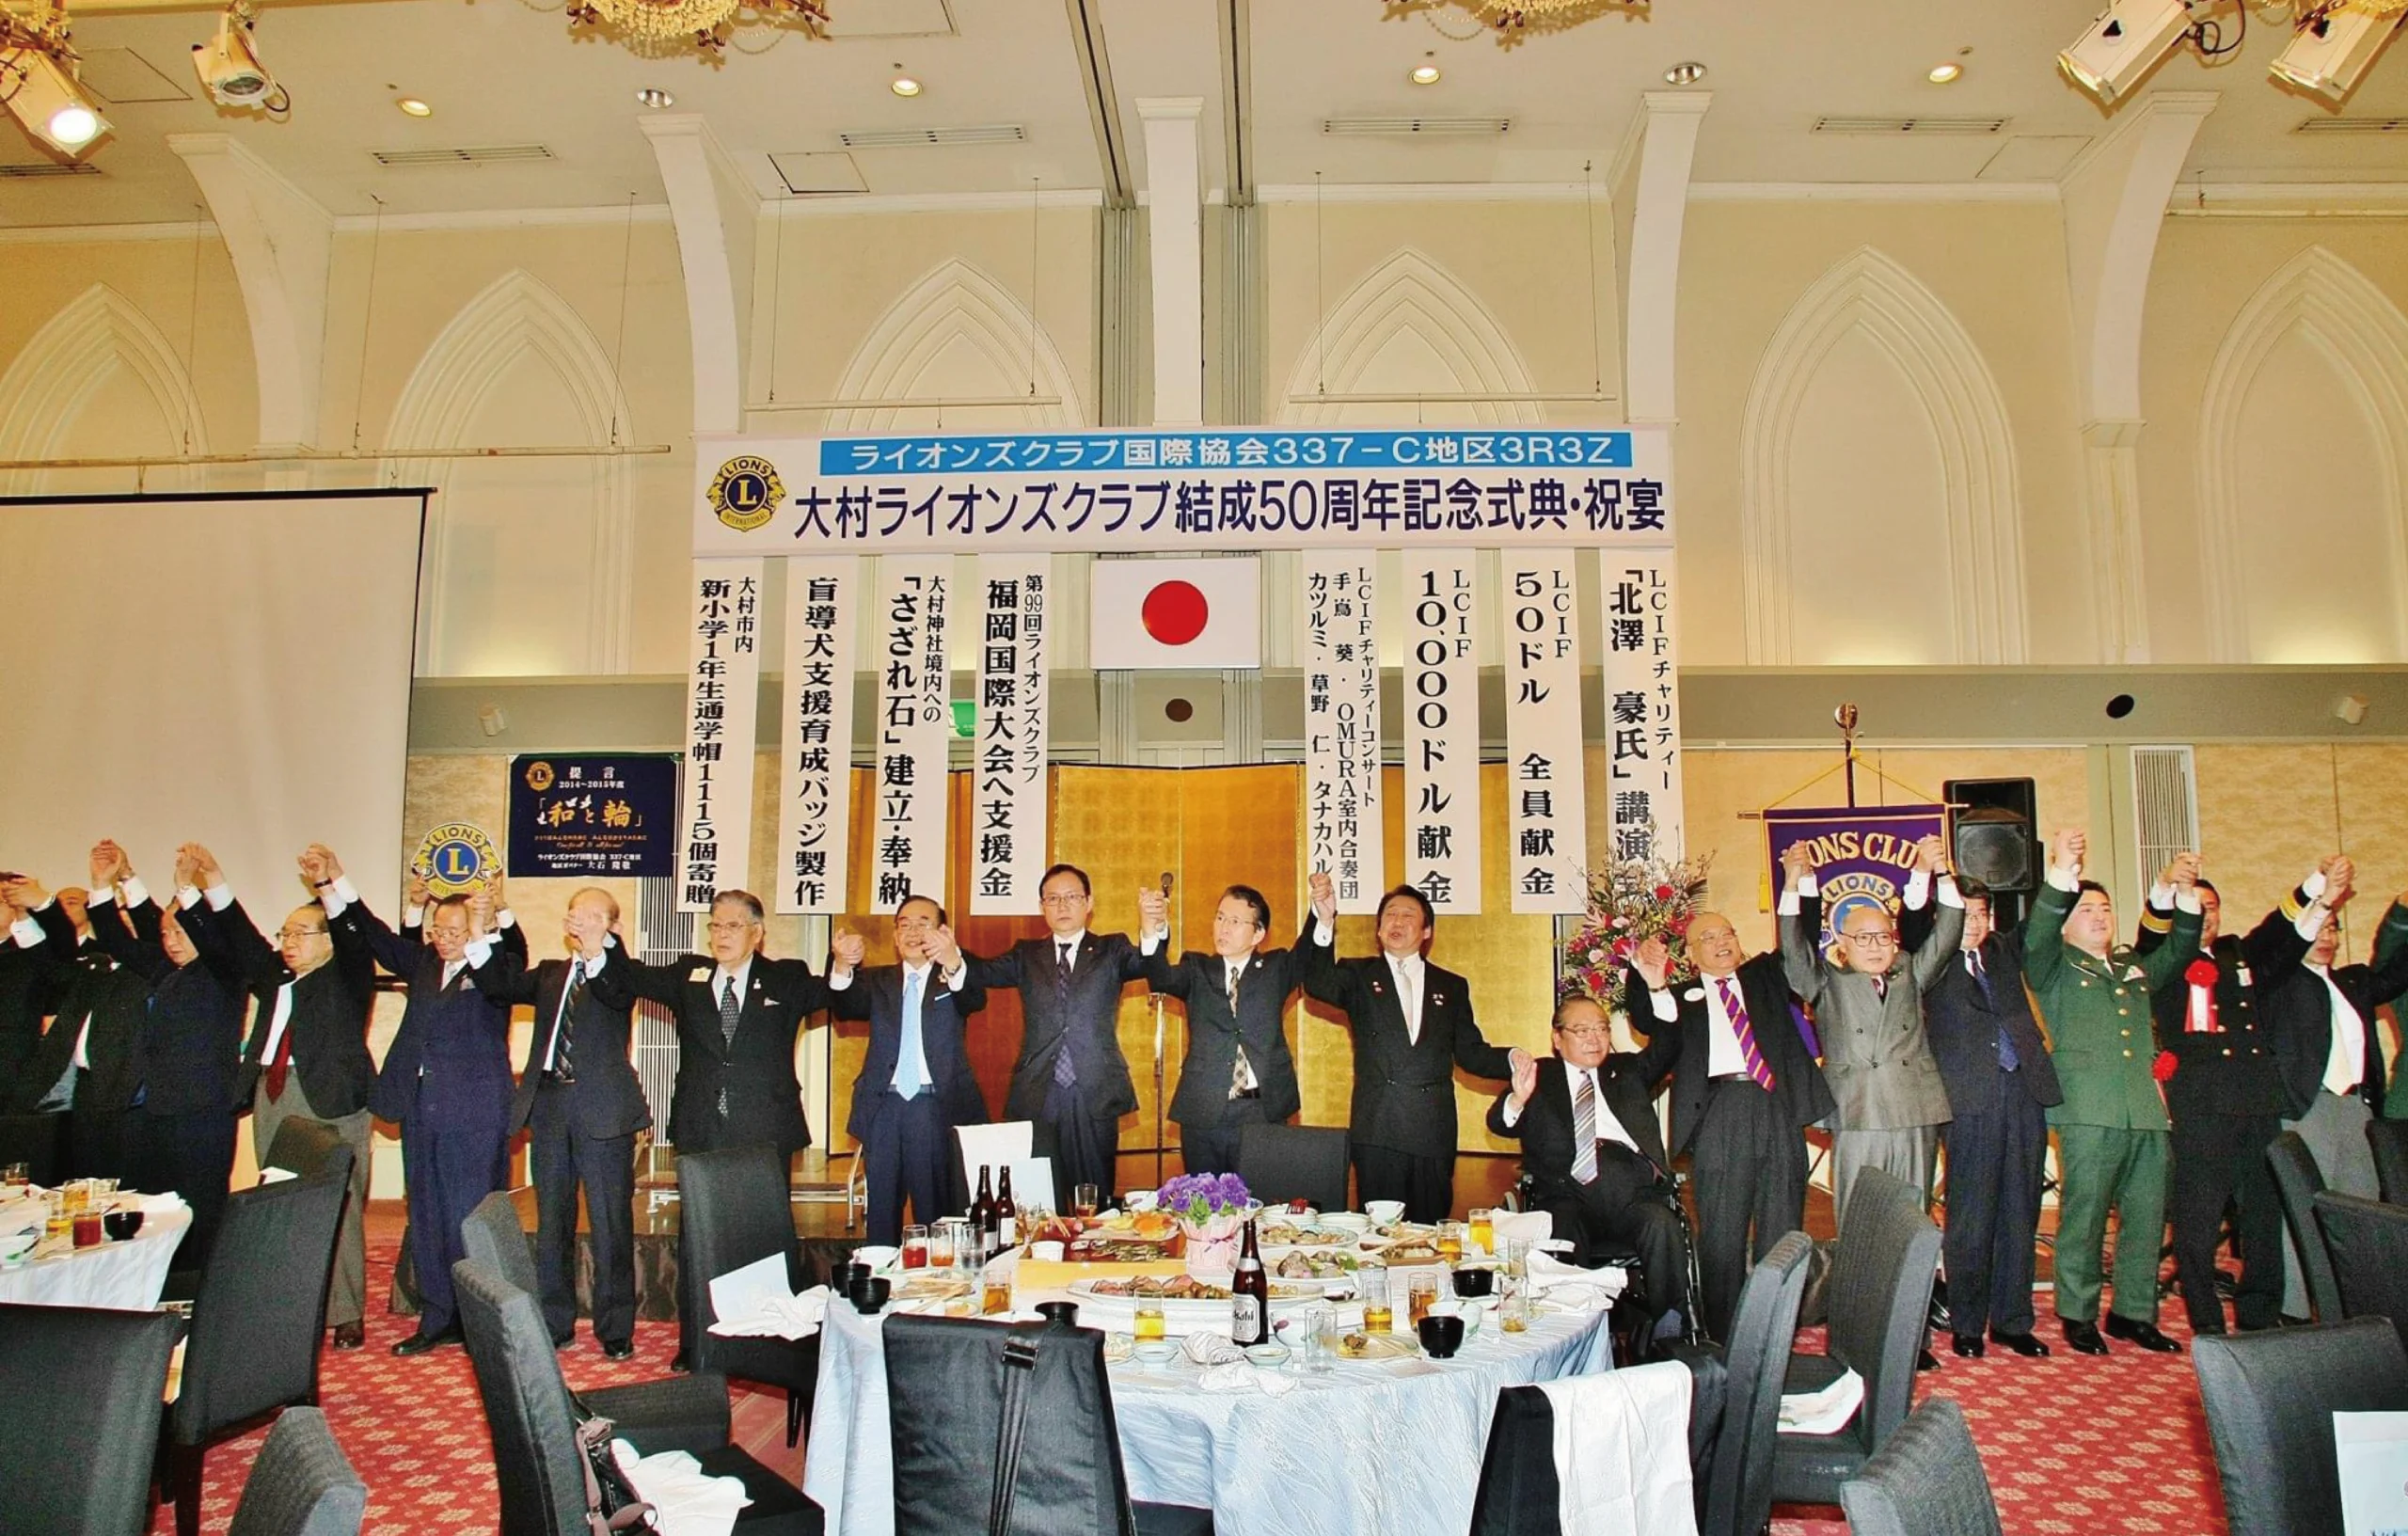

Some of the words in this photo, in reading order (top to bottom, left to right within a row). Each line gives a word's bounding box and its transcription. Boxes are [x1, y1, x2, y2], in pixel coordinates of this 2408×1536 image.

[724, 459, 769, 475] LIONS
[737, 480, 757, 505] L
[794, 478, 1666, 539] 大村ライオンズクラブ結成50周年記念式典・祝宴
[734, 576, 756, 654] 大村市内
[923, 575, 946, 723] 大村神社境内への
[1453, 569, 1472, 658] LCIF
[1552, 570, 1573, 658] LCIF
[1022, 574, 1044, 784] 第99回ライオンズクラブ
[1357, 566, 1377, 808] LCIFチャリティーコンサート
[1649, 569, 1671, 791] LCIFチャリティー
[685, 578, 733, 904] 新小学1年生通学帽1115個寄贈
[794, 577, 839, 907] 盲導犬支援育成バッジ製作
[879, 575, 922, 906] 「さざれ石」建立・奉納
[979, 578, 1020, 897] 福岡国際大会へ支援金
[433, 827, 483, 844] LIONS
[447, 847, 470, 875] L
[1806, 831, 1861, 868] ONS
[1863, 832, 1920, 869] CLU
[1826, 876, 1890, 898] LIONS
